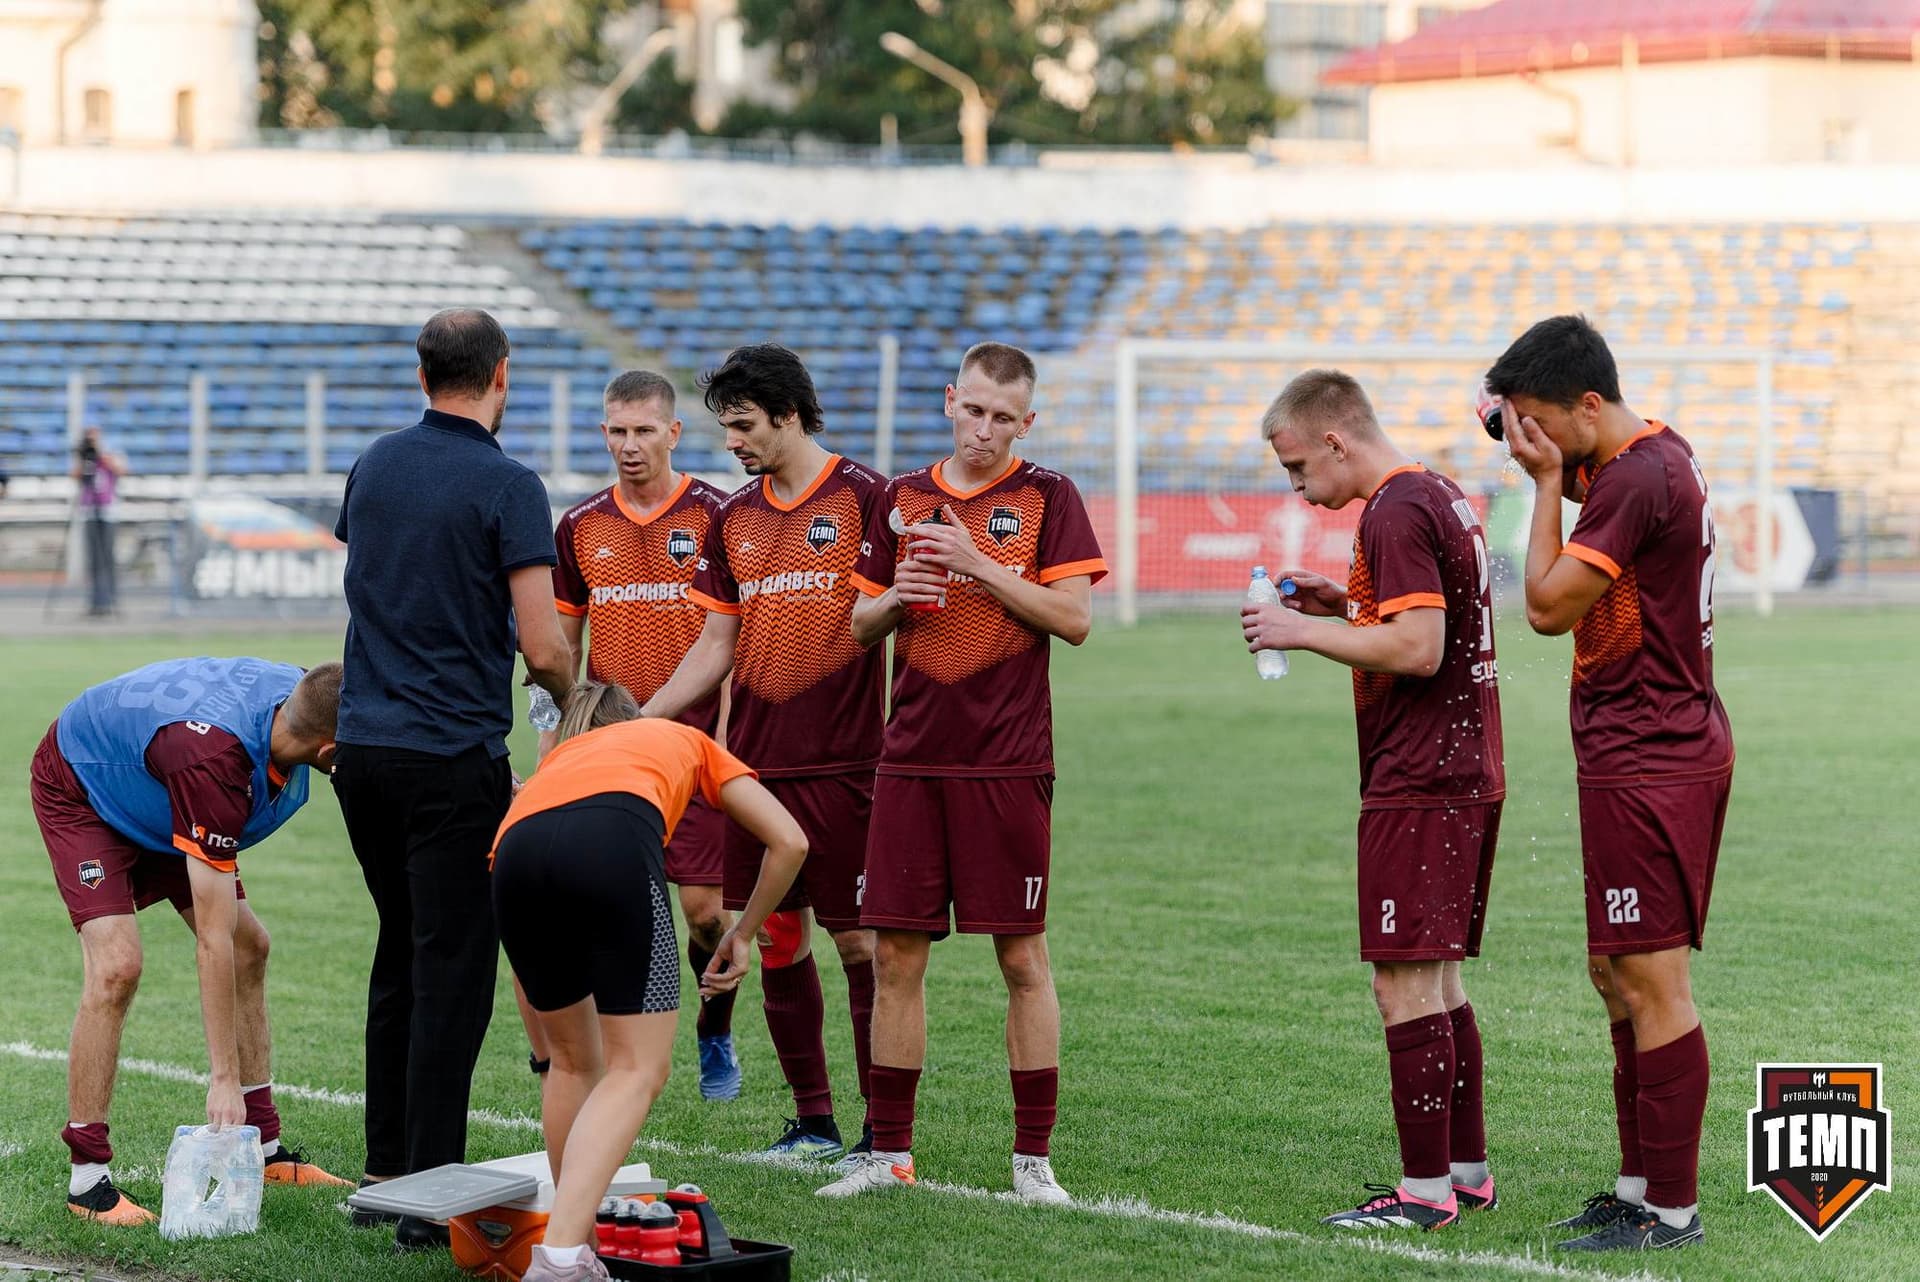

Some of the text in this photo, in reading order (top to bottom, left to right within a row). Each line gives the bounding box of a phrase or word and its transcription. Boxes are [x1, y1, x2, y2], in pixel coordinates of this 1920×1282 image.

[810, 525, 836, 542] ТЕМП
[991, 517, 1019, 534] ТЕМП
[670, 539, 695, 555] ТЕМП
[591, 582, 690, 606] ПРОДИНВЕС
[81, 867, 102, 881] ТЕМП
[1025, 876, 1043, 910] 17
[1381, 899, 1396, 933] 2
[1606, 888, 1641, 924] 22
